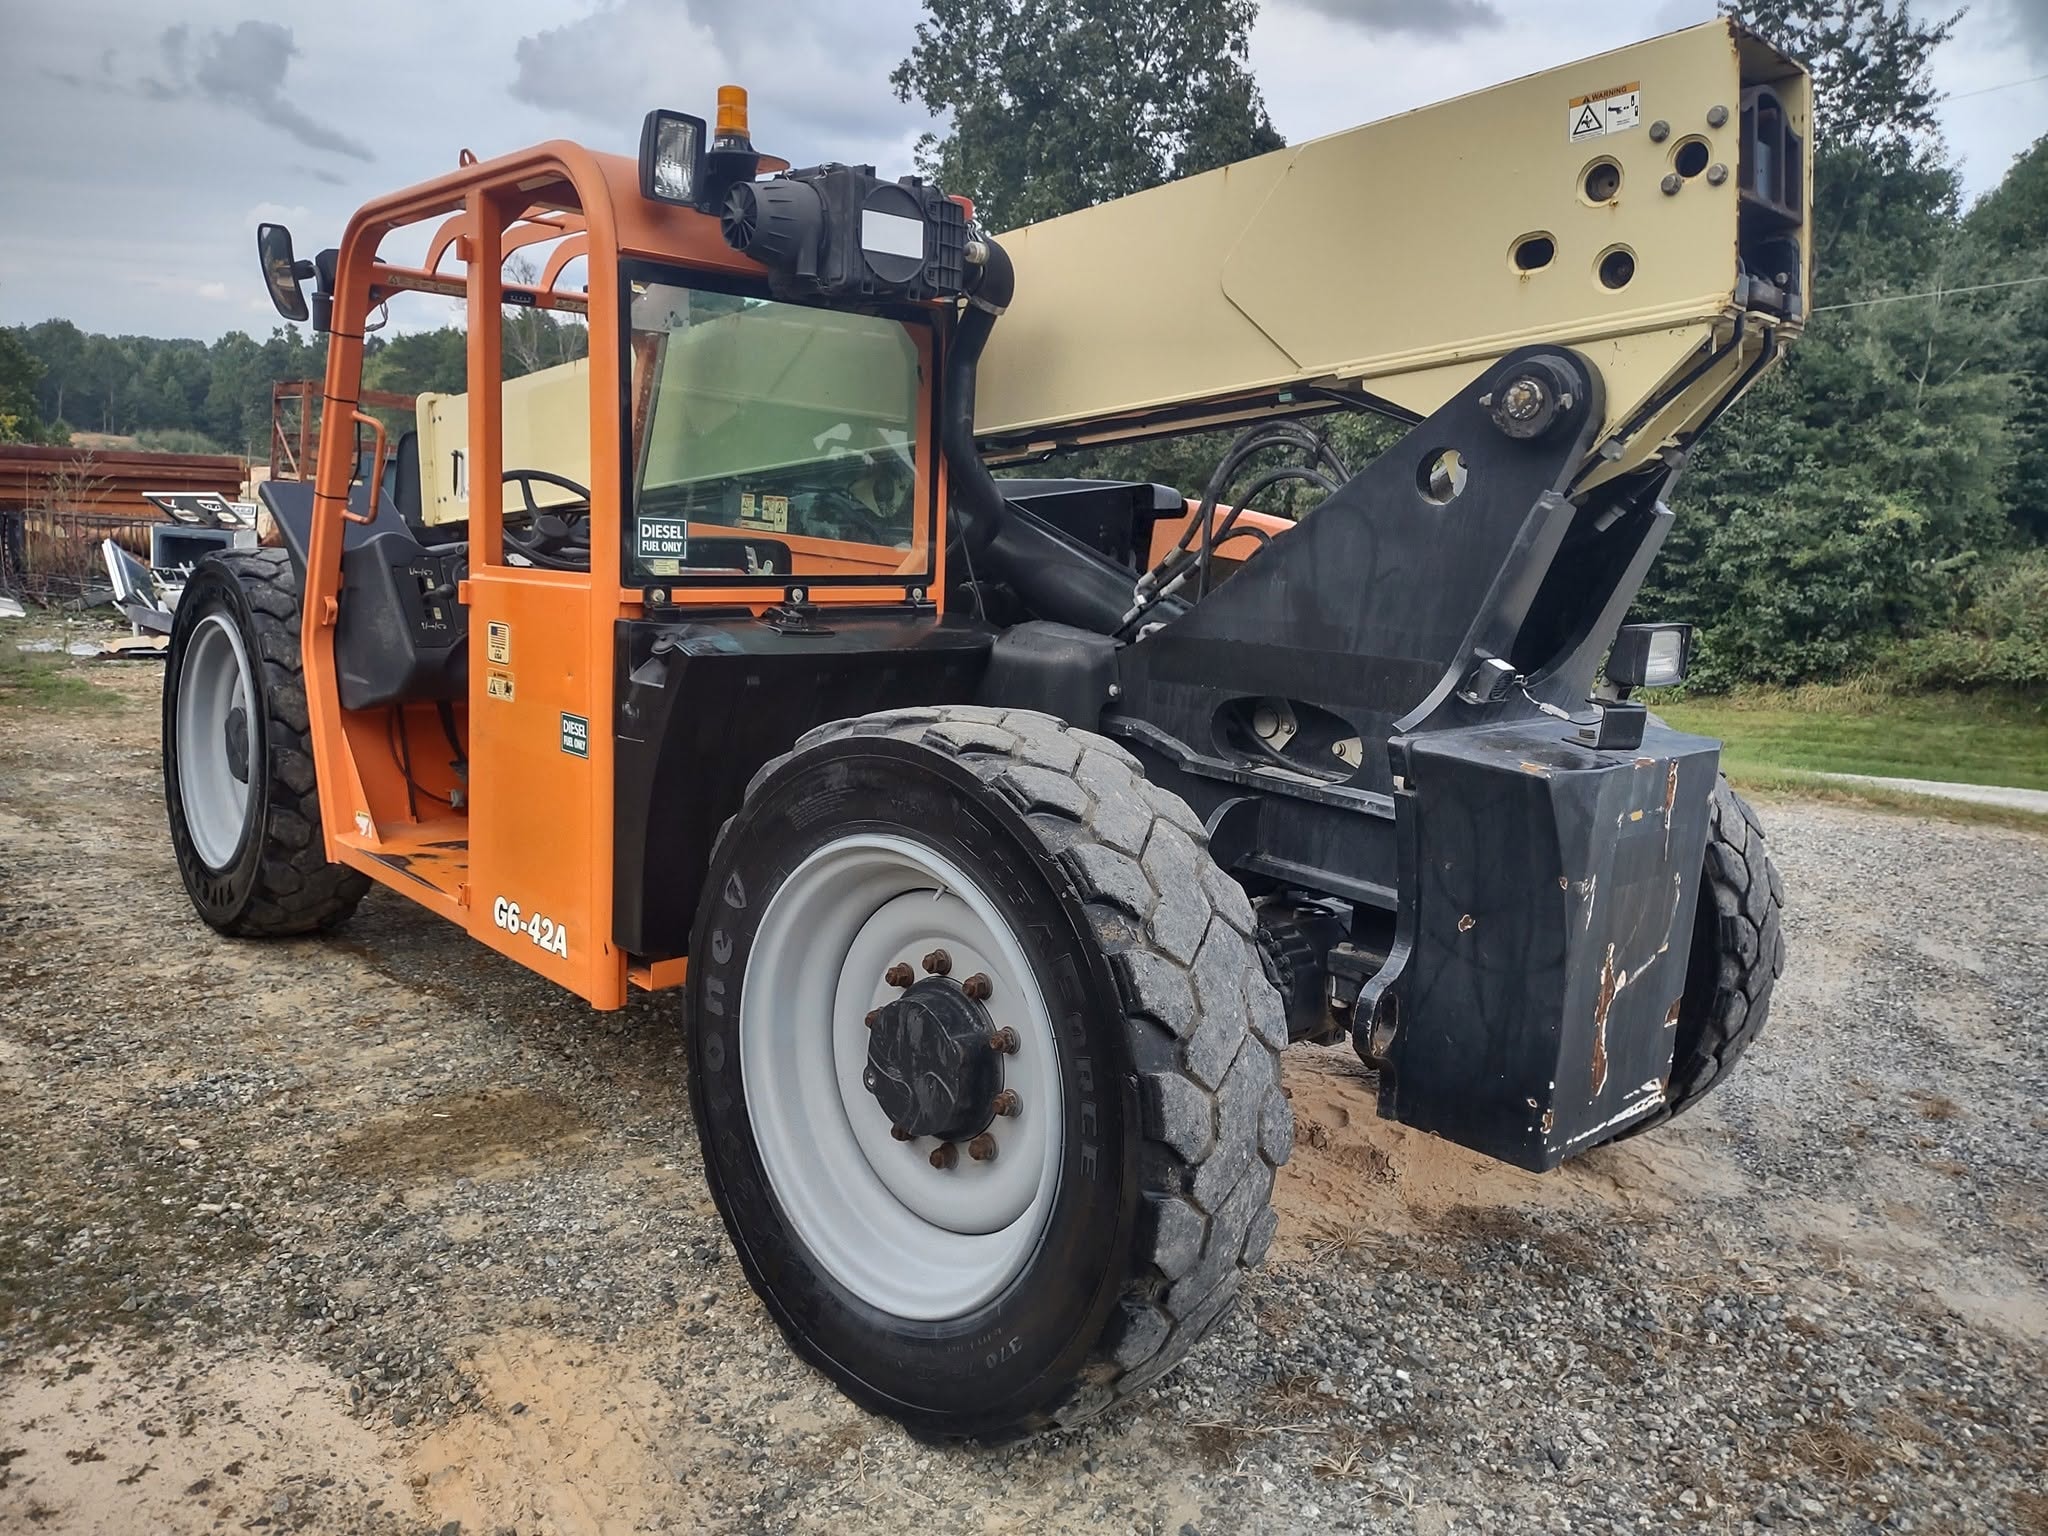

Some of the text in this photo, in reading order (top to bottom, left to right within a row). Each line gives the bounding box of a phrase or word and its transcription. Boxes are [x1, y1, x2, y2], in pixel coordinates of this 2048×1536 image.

[1592, 86, 1627, 101] WARNING
[641, 524, 684, 540] DIESEL
[642, 540, 682, 553] FUEL ONLY
[563, 719, 587, 738] DIESEL
[494, 895, 567, 960] G6-42A
